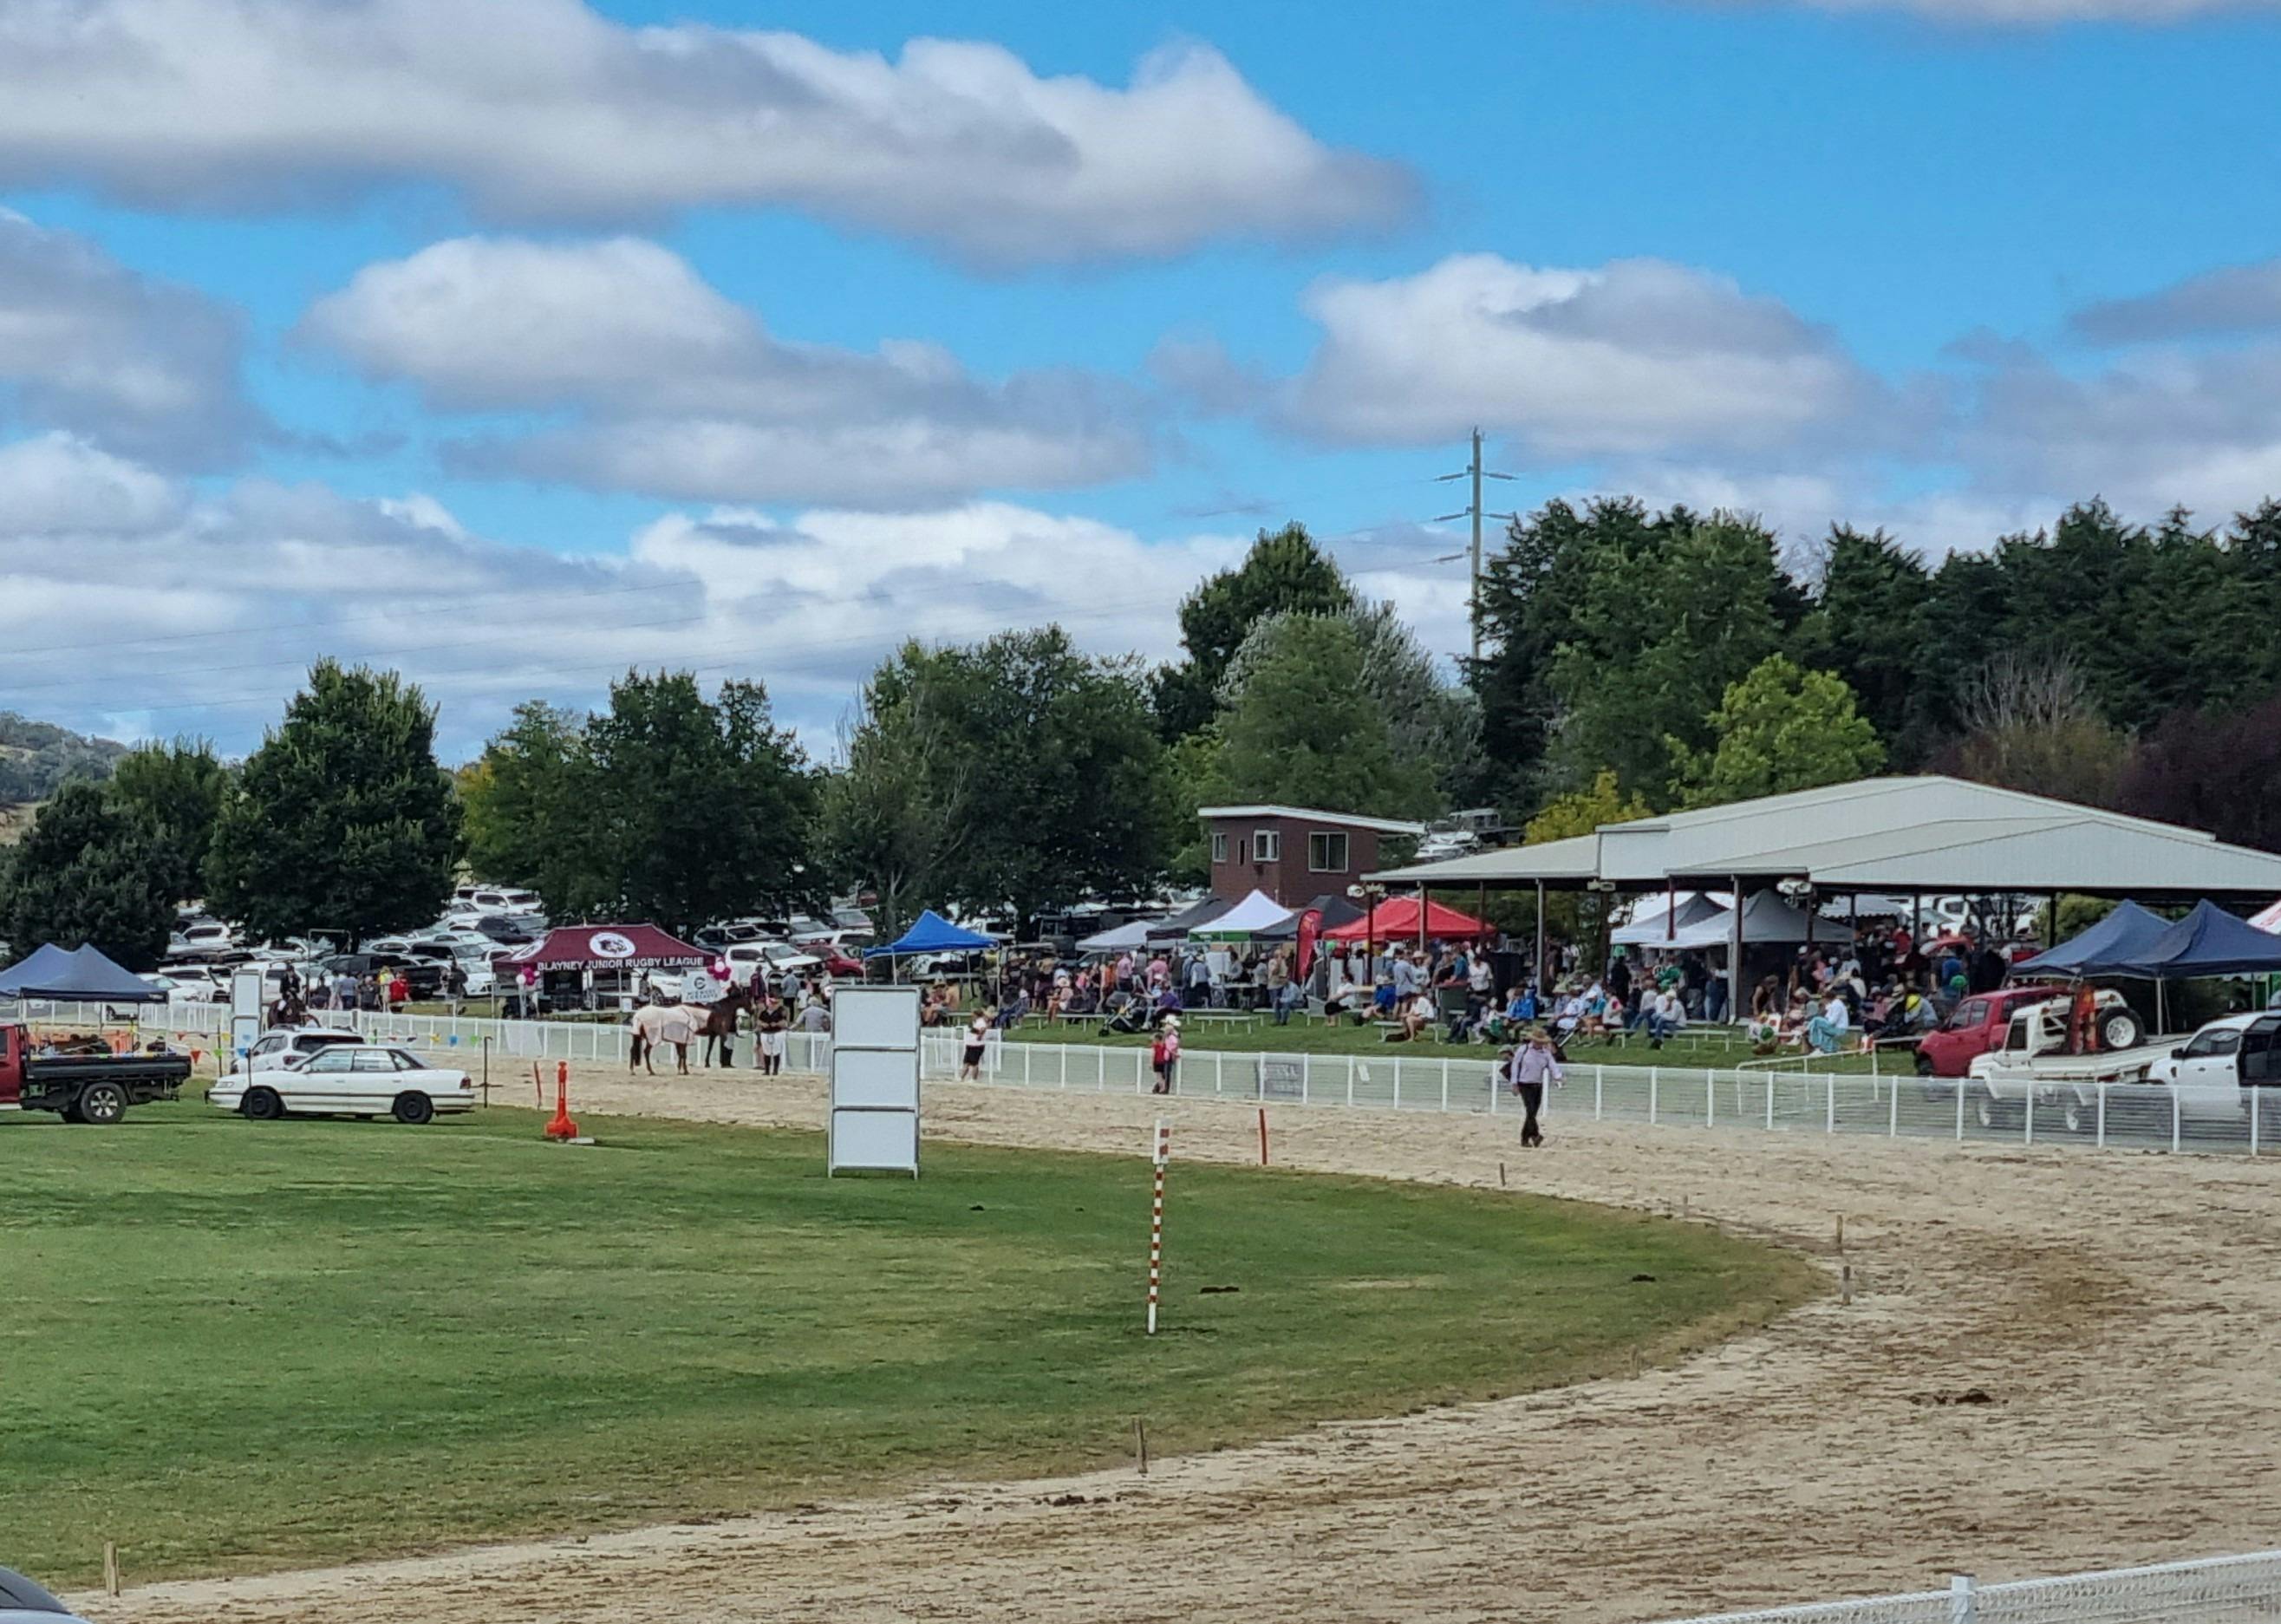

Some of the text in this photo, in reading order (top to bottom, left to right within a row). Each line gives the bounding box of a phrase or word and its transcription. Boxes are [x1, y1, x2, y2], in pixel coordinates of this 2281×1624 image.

[537, 956, 704, 971] BLAYNEY JUNIOR RUGBY LEAGUE
